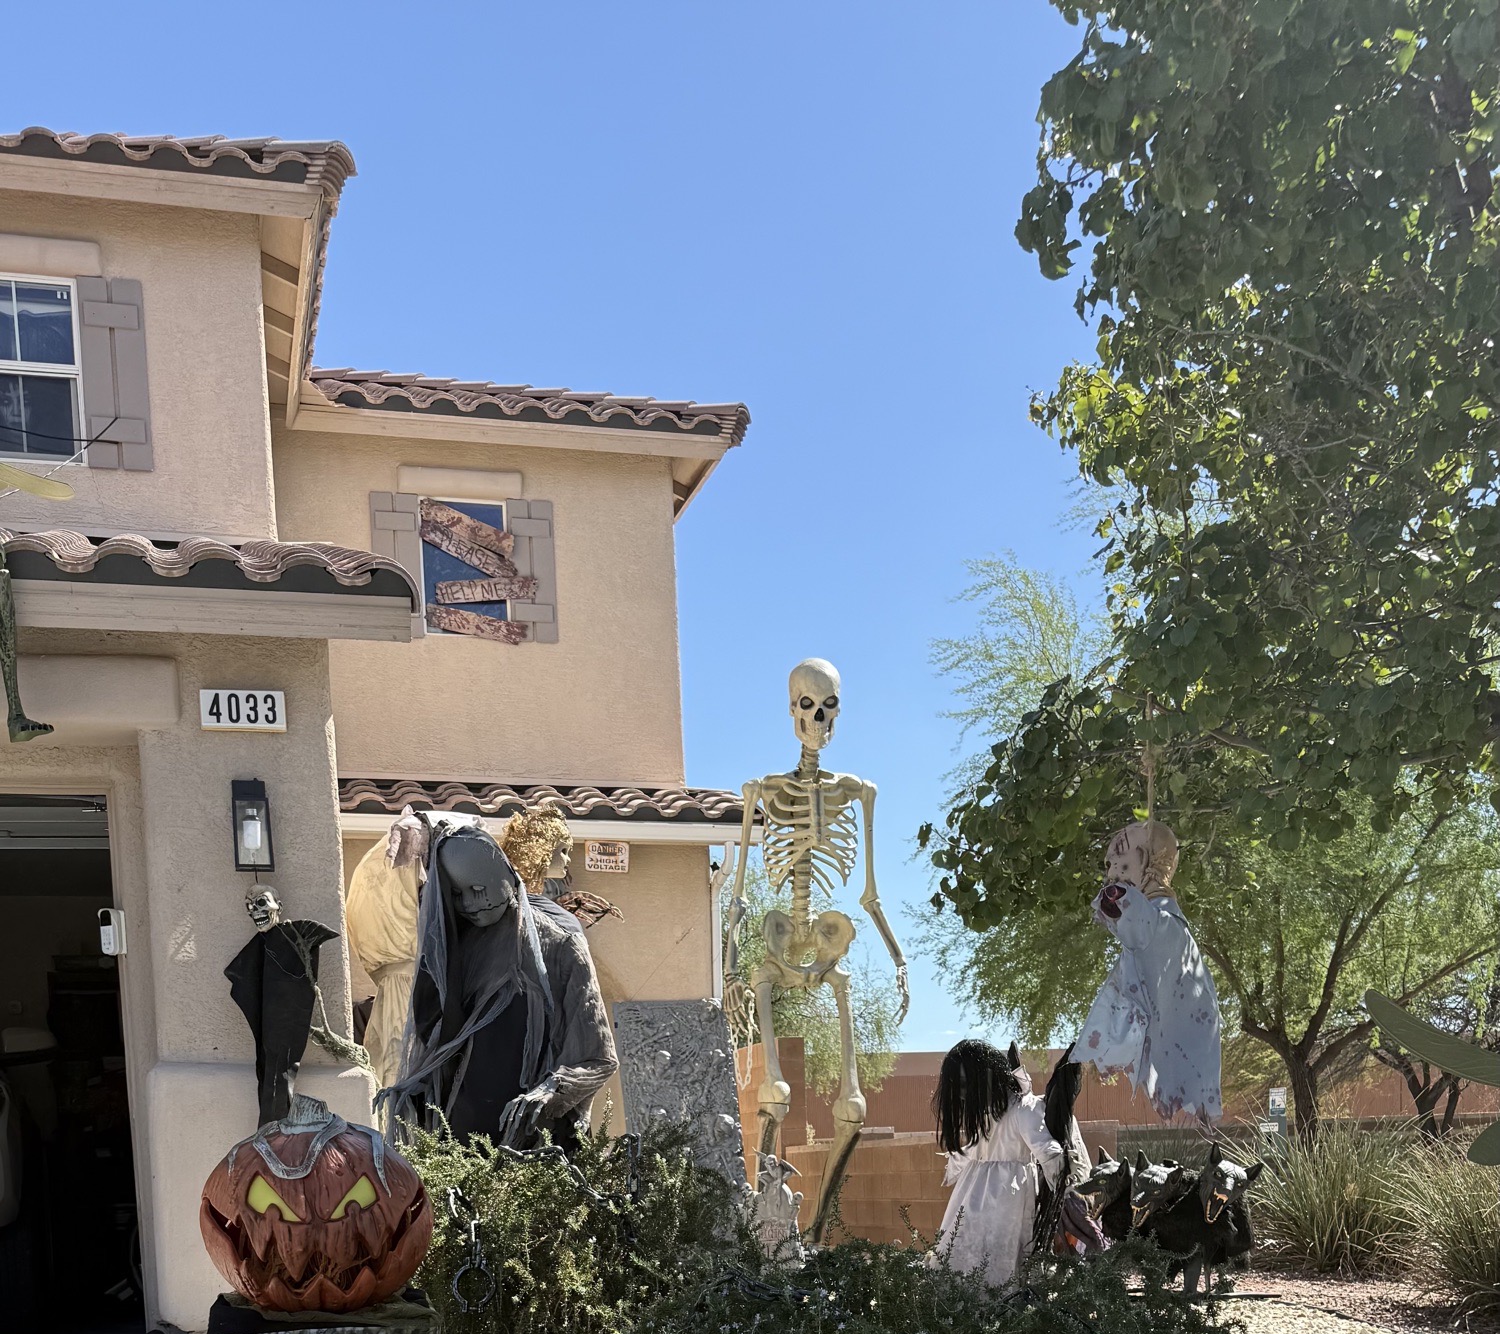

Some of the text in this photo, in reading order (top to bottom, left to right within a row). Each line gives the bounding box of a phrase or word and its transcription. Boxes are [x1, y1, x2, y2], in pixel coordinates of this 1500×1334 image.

[443, 529, 496, 571] PLEASE
[439, 580, 503, 603] HELP ME
[209, 693, 276, 724] 4033
